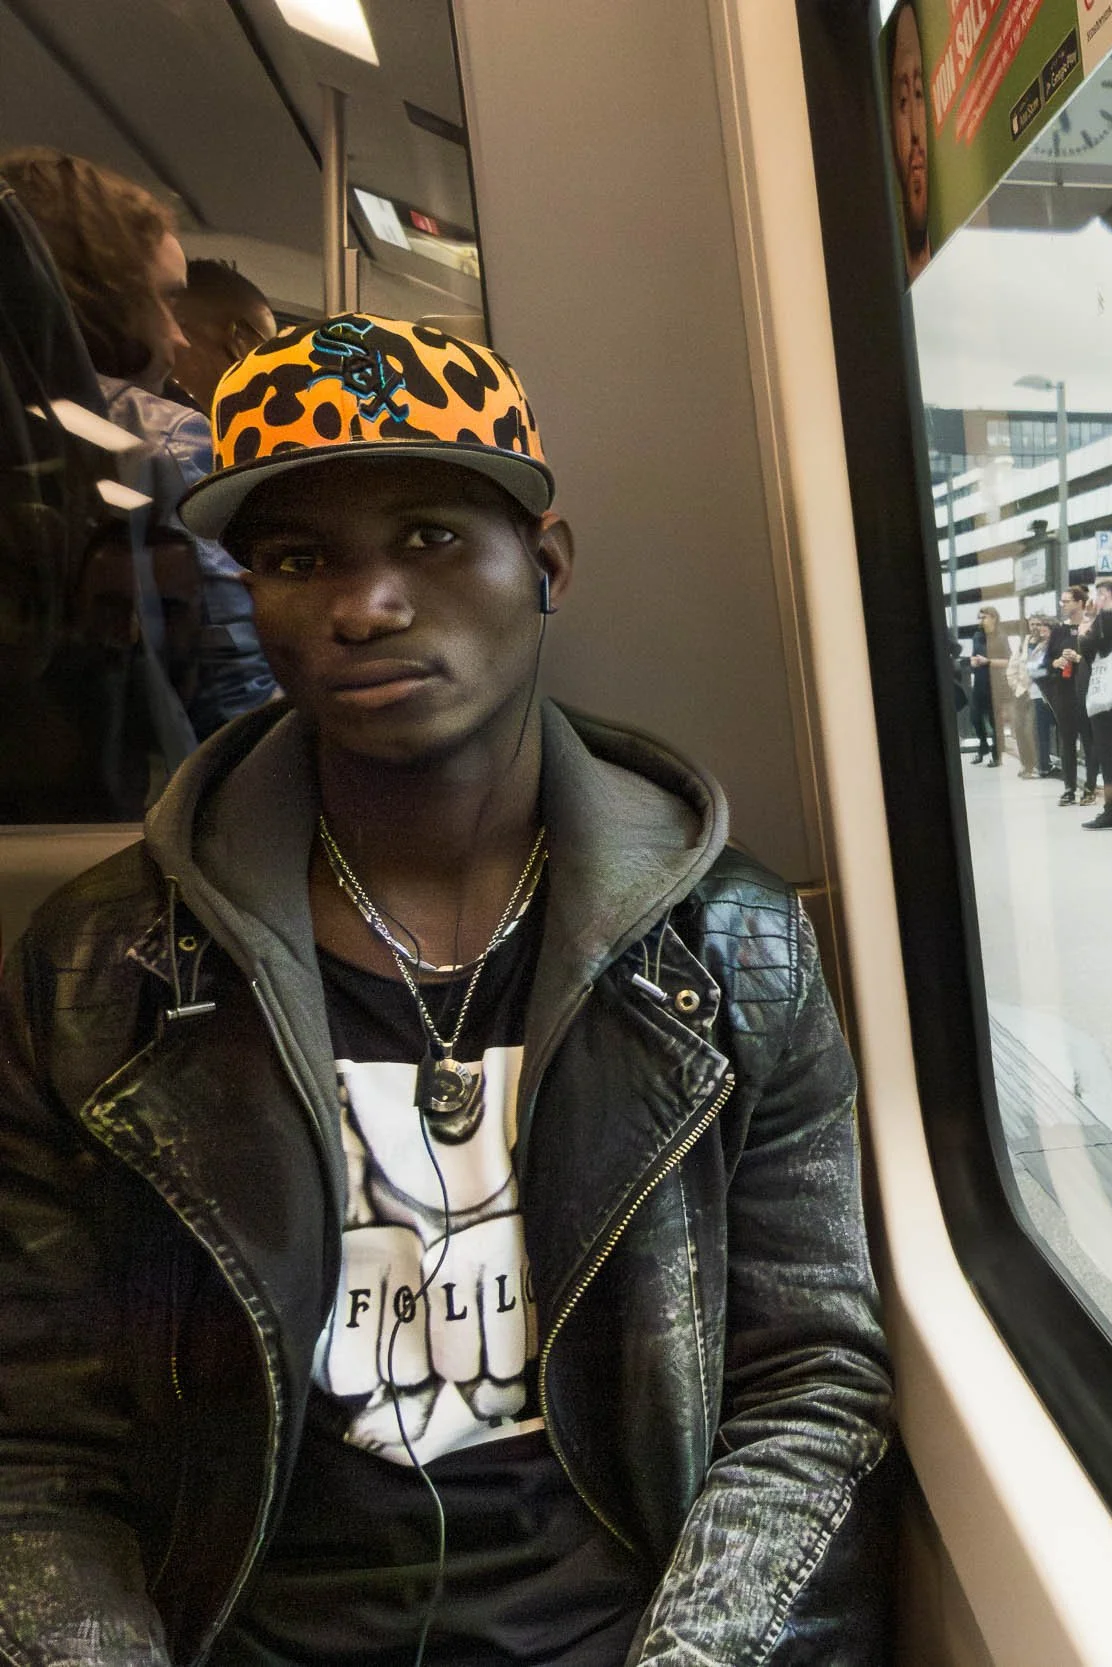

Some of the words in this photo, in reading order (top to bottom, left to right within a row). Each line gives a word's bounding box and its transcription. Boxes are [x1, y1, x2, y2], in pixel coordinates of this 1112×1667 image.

[1099, 533, 1109, 548] P
[1101, 555, 1111, 570] A
[345, 1265, 536, 1329] FOLL
